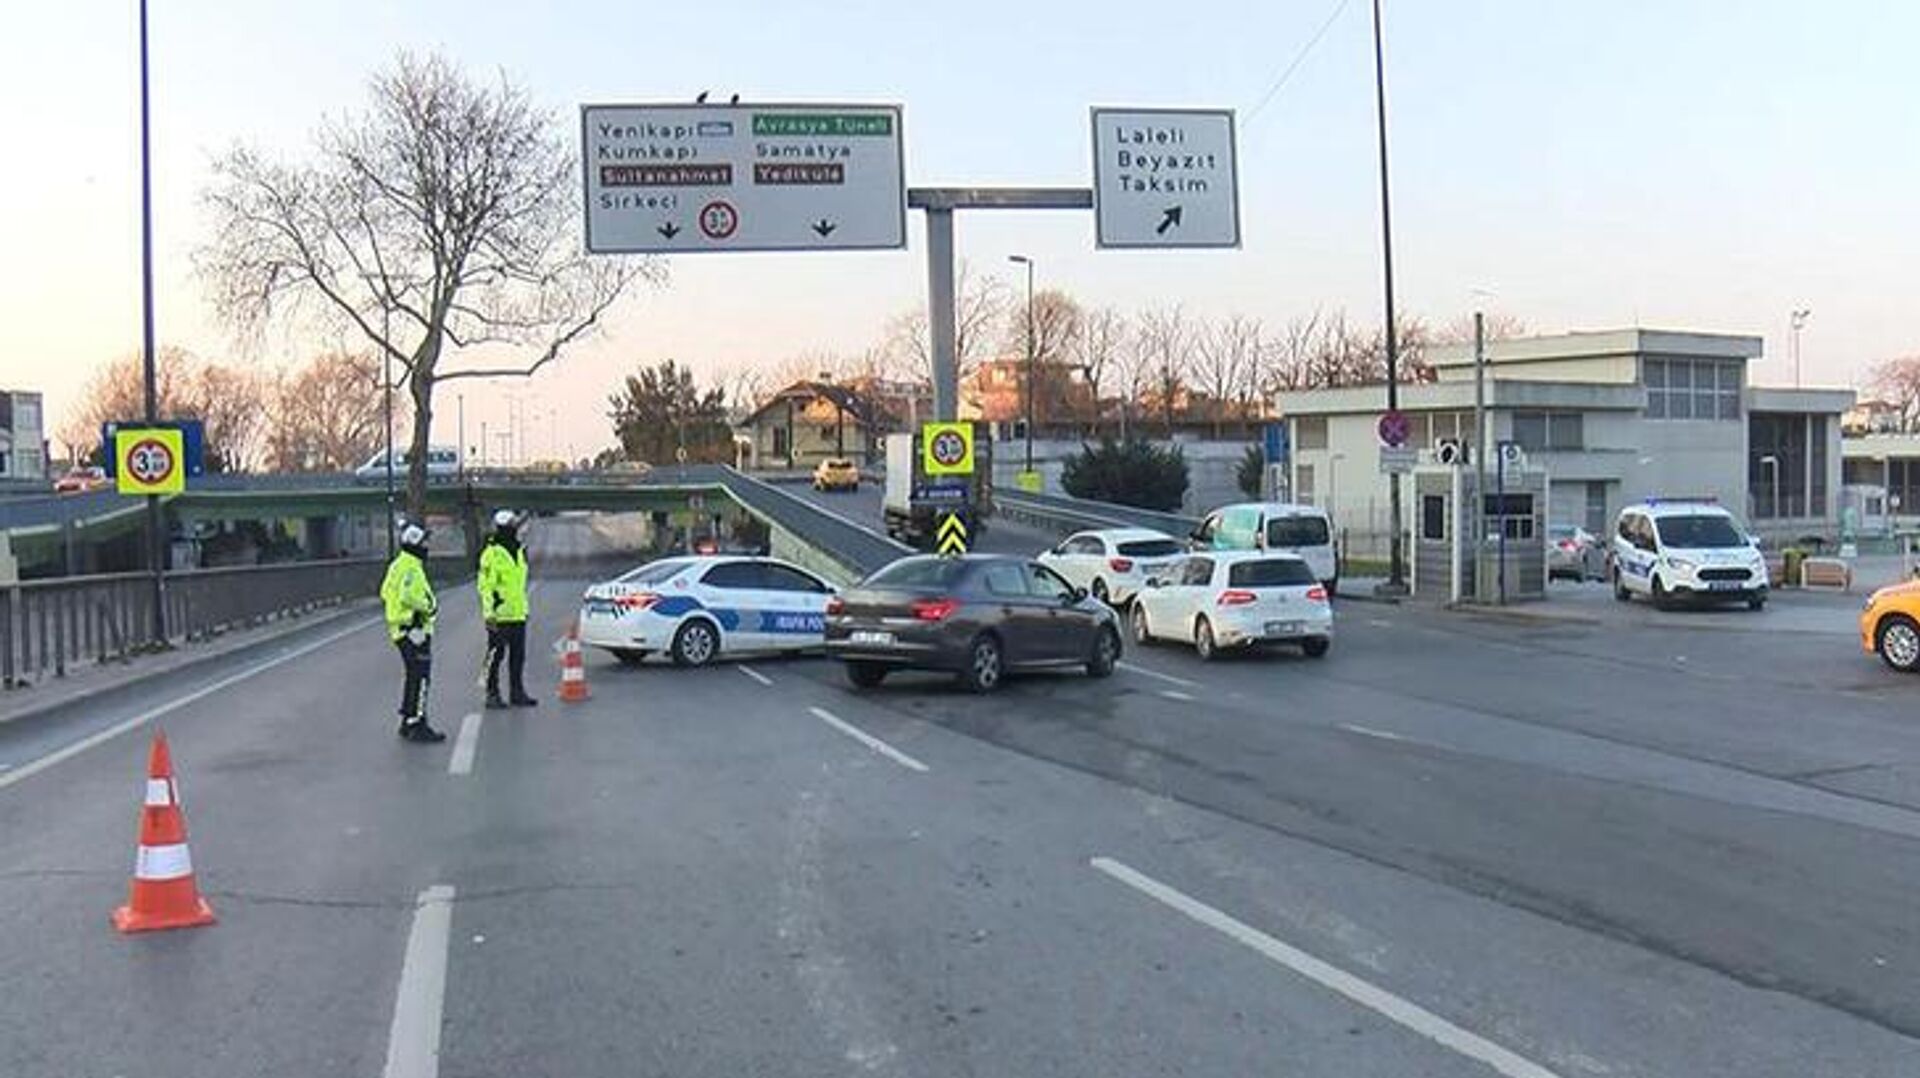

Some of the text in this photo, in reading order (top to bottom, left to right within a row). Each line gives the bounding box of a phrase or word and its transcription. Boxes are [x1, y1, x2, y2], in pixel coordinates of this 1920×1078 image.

[598, 121, 693, 140] Yenikapı
[756, 117, 828, 134] Avrasya
[1117, 126, 1184, 144] Laleli
[598, 144, 698, 161] Kumkapı
[756, 143, 851, 160] Samatya
[1118, 151, 1216, 172] Beyazıt
[602, 167, 729, 184] Sultanahmet
[759, 166, 841, 181] Yedikule
[1119, 175, 1208, 193] Taksim
[599, 192, 678, 210] Sirkeci
